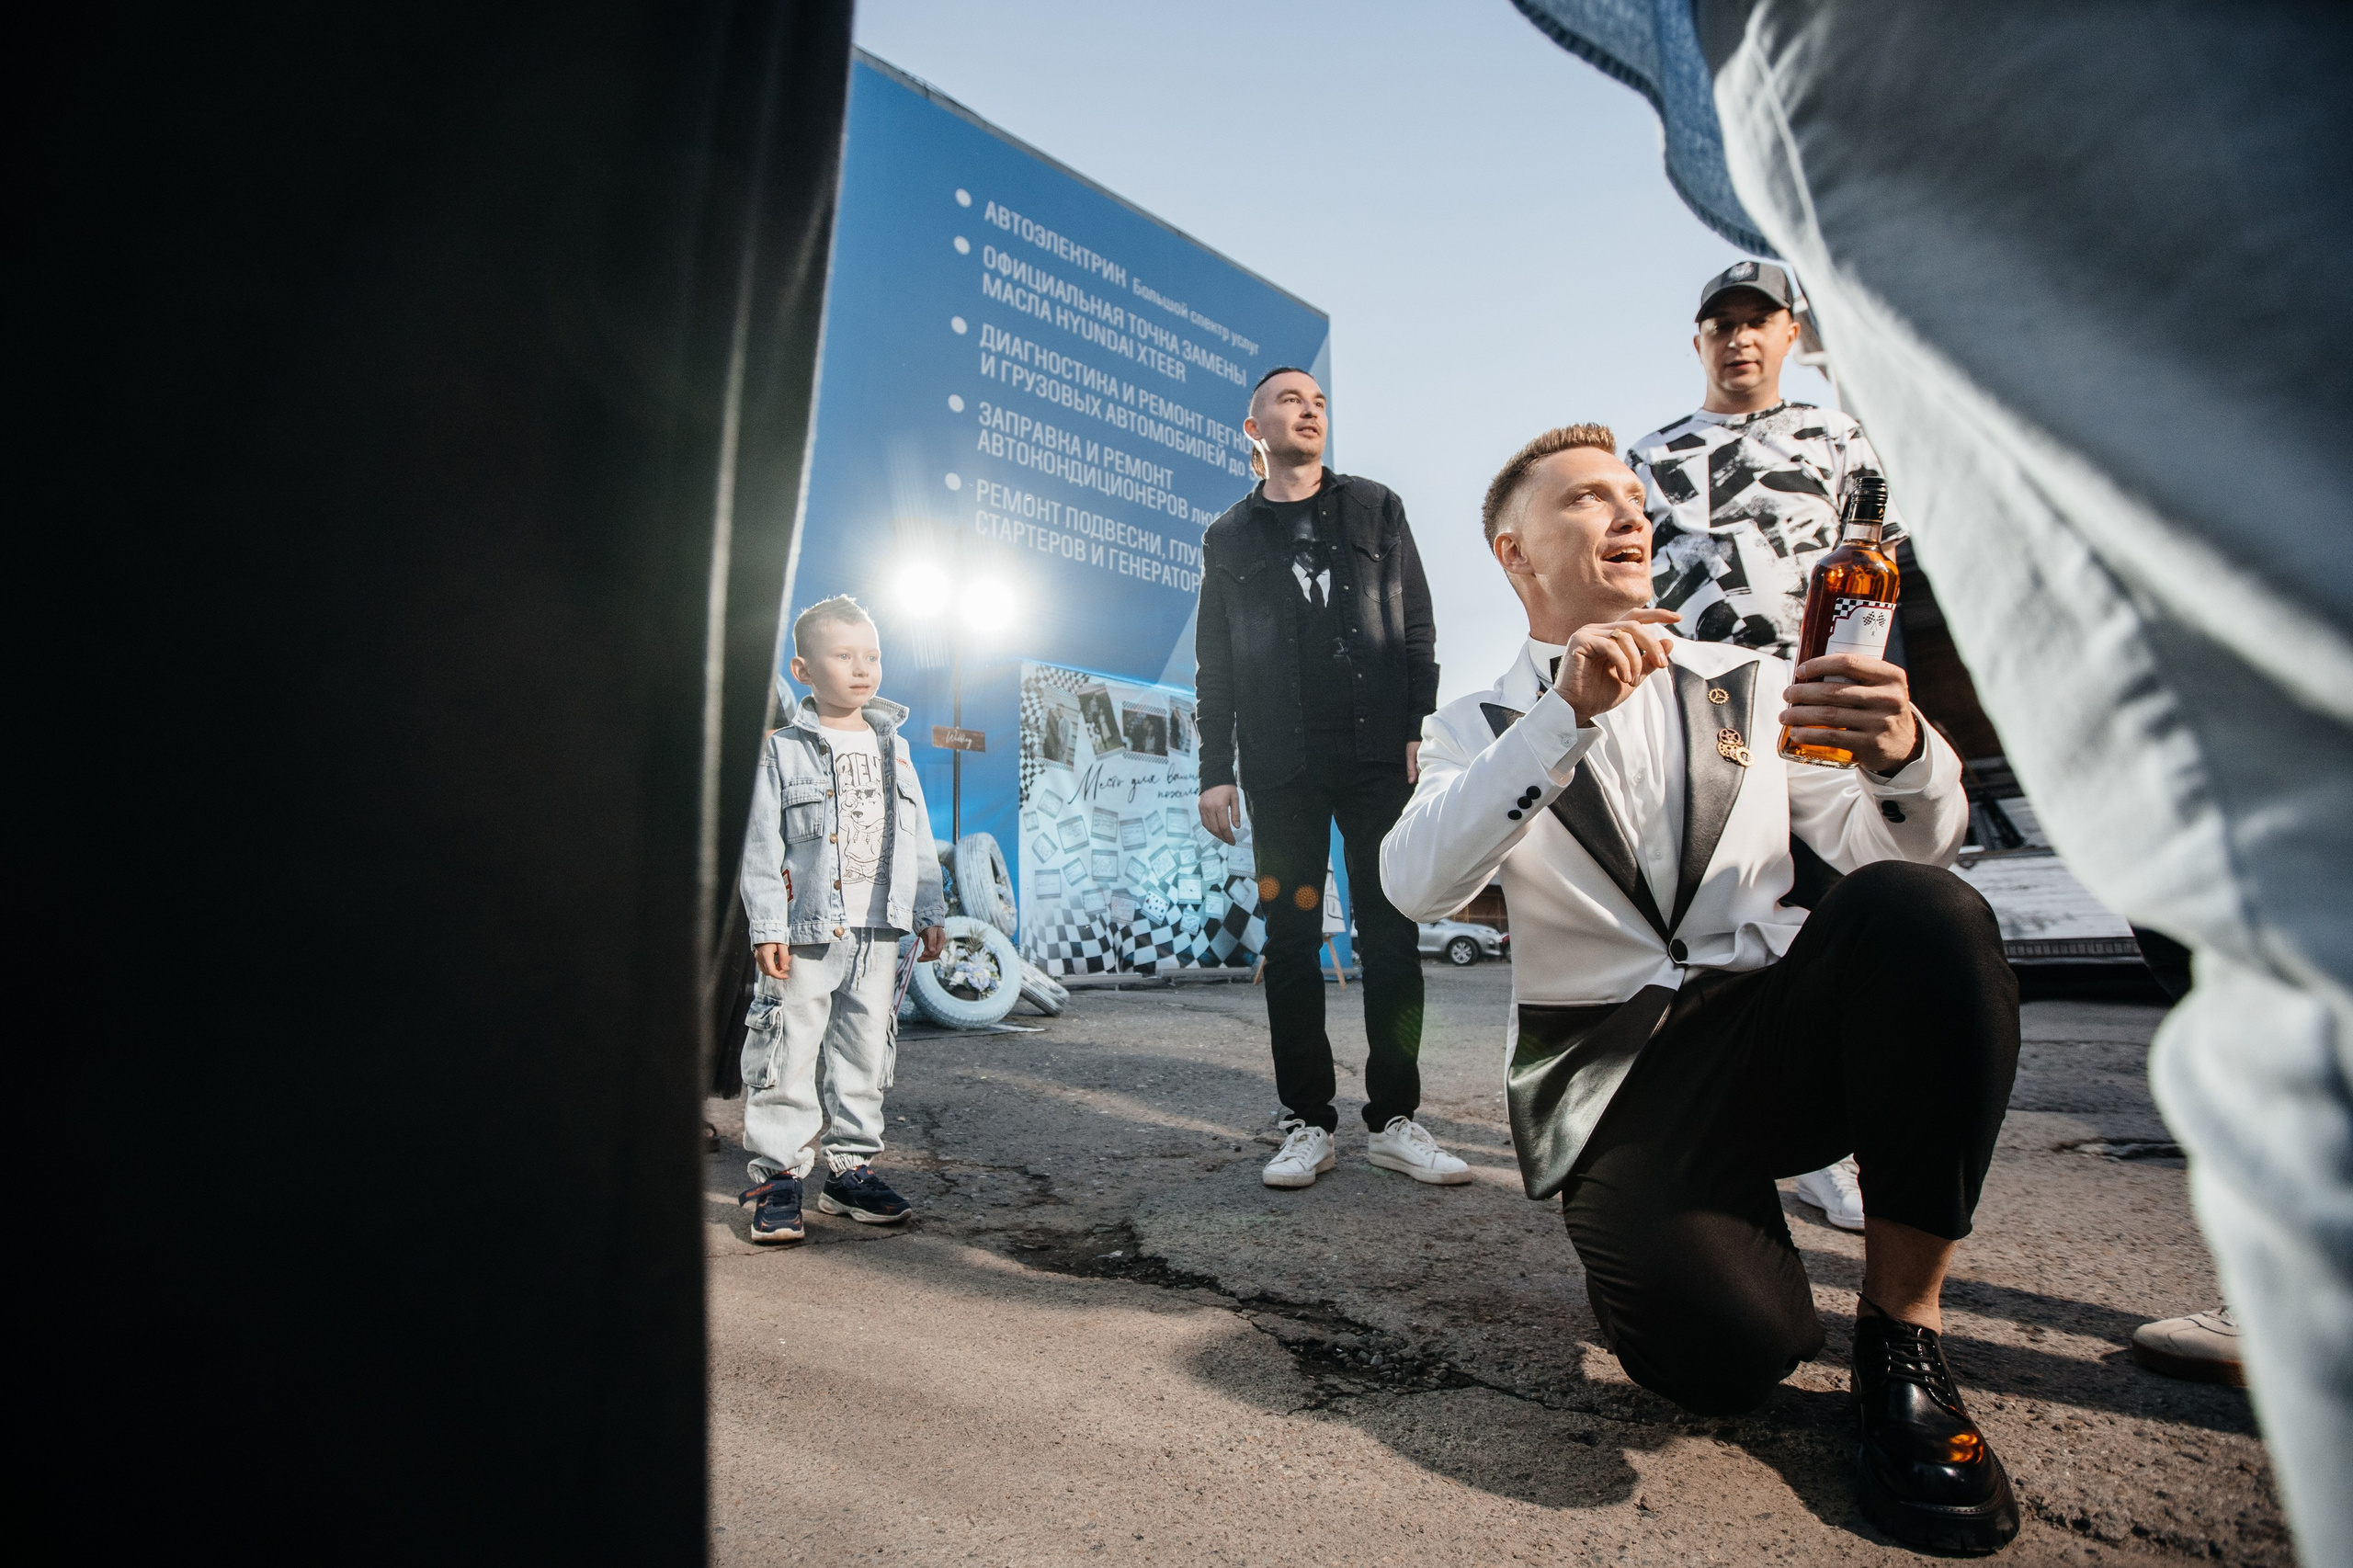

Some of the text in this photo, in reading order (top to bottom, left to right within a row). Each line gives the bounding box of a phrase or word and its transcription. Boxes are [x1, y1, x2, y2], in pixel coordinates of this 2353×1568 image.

[983, 244, 1246, 388] ОФИЦИАЛЬНАЯ ТОЧКА ЗАМЕНЫ
[983, 272, 1187, 383] МАСЛА HYUNDAI XTEER
[984, 199, 1260, 357] АВТОЭЛЕКТРИК Большой спектр услуг
[979, 323, 1119, 399] ДИАГНОСТИКА
[1122, 381, 1135, 406] И
[1139, 388, 1204, 434] РЕМОНТ
[981, 351, 995, 380] И
[1001, 359, 1102, 420] ГРУЗОВЫХ
[1105, 402, 1226, 469] АВТОМОБИЛЕЙ
[1228, 457, 1245, 477] до
[977, 428, 1188, 519] АВТОКОНДИЦИОНЕРОВ
[978, 401, 1174, 490] ЗАПРАВКА И РЕМОНТ
[975, 509, 1086, 562] СТАРТЕРОВ
[1091, 542, 1104, 568] И
[976, 478, 1062, 525] РЕМОНТ
[1065, 506, 1165, 560] ПОДВЕСКИ,
